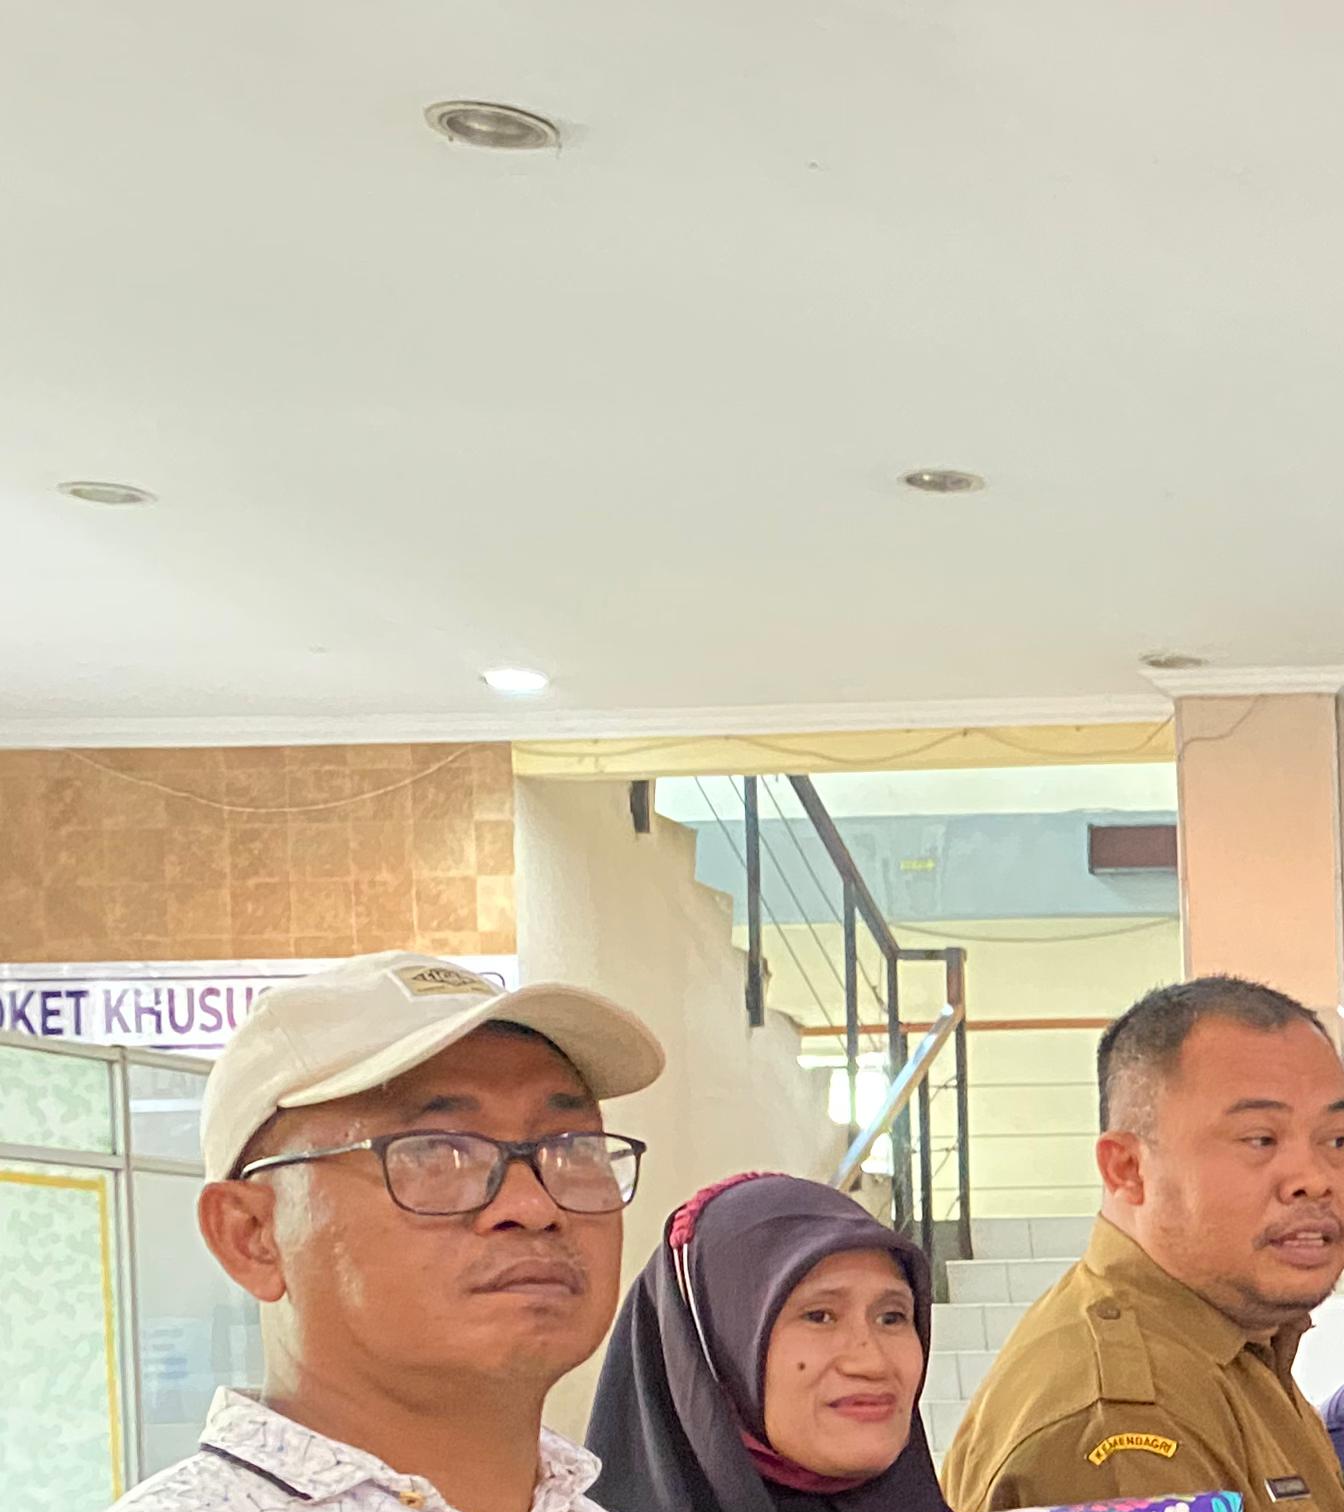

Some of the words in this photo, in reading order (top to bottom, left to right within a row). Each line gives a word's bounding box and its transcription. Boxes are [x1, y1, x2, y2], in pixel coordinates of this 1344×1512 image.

[0, 989, 90, 1036] KET
[103, 986, 272, 1035] KHUSU
[1095, 1435, 1173, 1461] KEMENDAGRI
